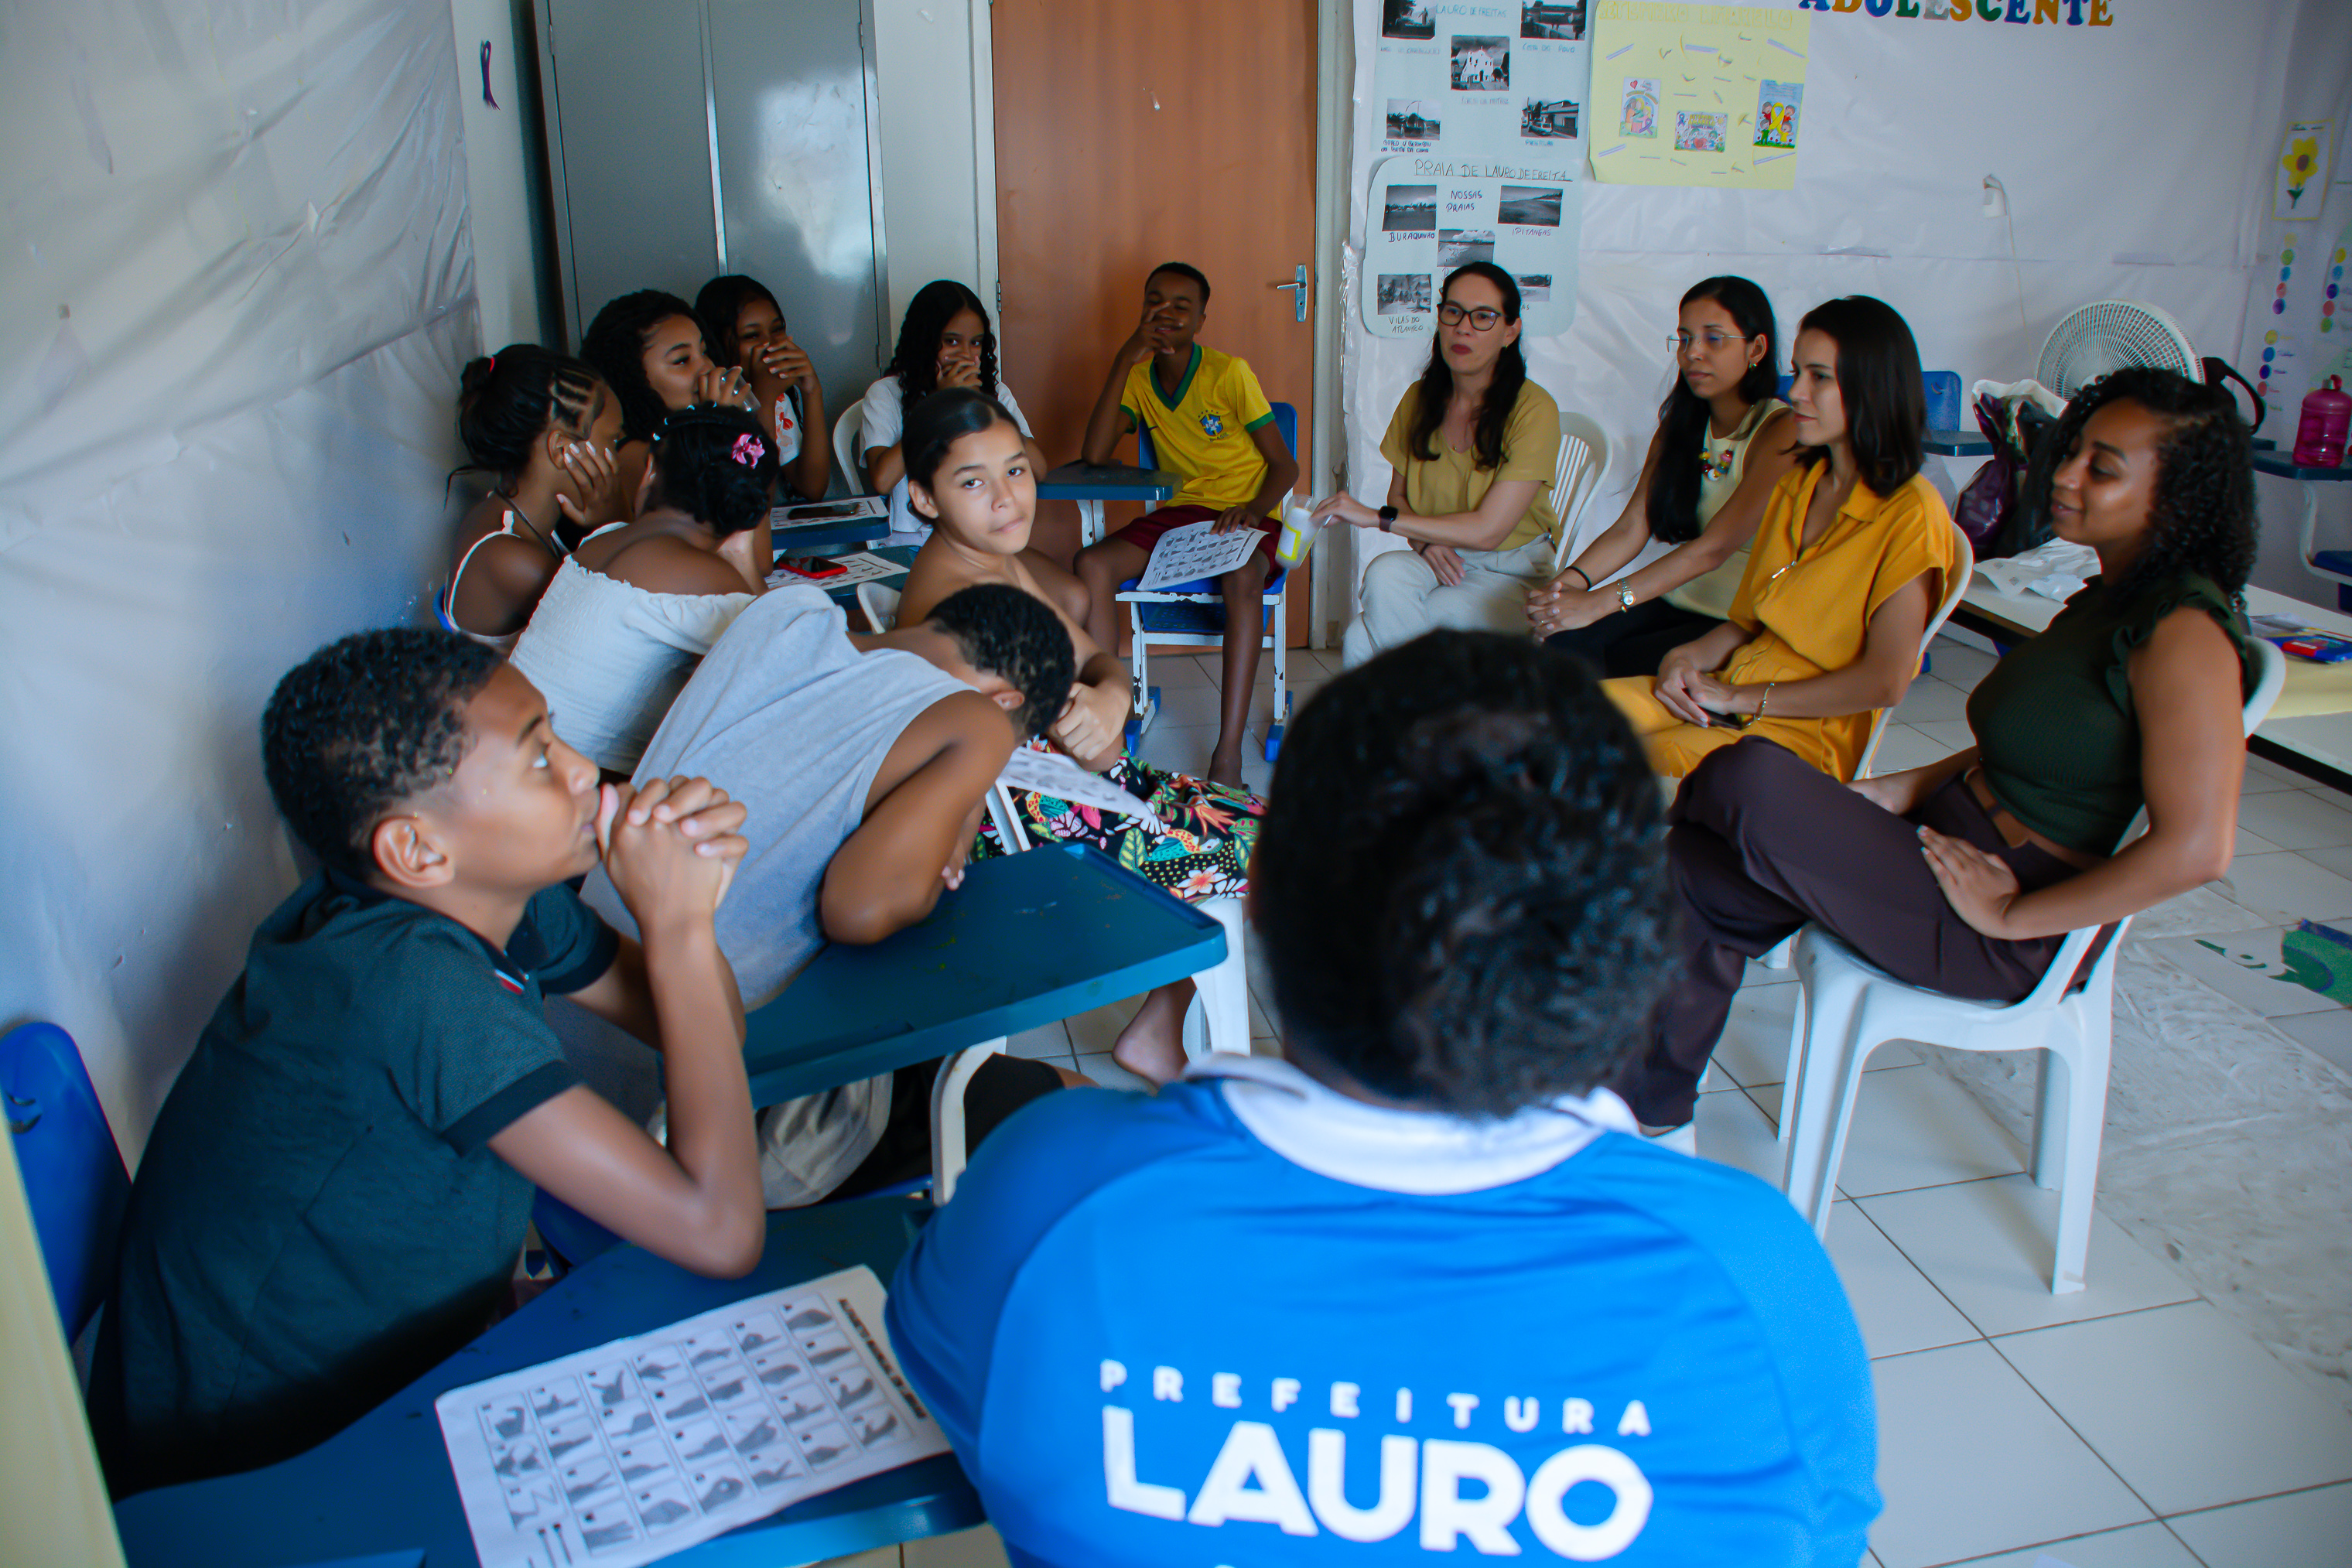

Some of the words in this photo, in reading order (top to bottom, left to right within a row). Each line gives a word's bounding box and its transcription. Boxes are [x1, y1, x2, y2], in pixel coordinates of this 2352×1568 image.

[1436, 4, 1467, 15] LAURO
[1479, 7, 1506, 18] FREITAS
[1700, 5, 1793, 30] AMARELO
[1414, 159, 1454, 176] PRAIA
[1461, 164, 1479, 178] DE
[1485, 164, 1516, 179] LAURO
[1517, 168, 1530, 179] DE
[1451, 190, 1483, 200] NOSSAS
[1445, 203, 1475, 213] PRAIAS
[1388, 315, 1409, 325] VILAS
[1099, 1358, 1653, 1437] PREFEITURA
[1102, 1404, 1654, 1563] LAURO
